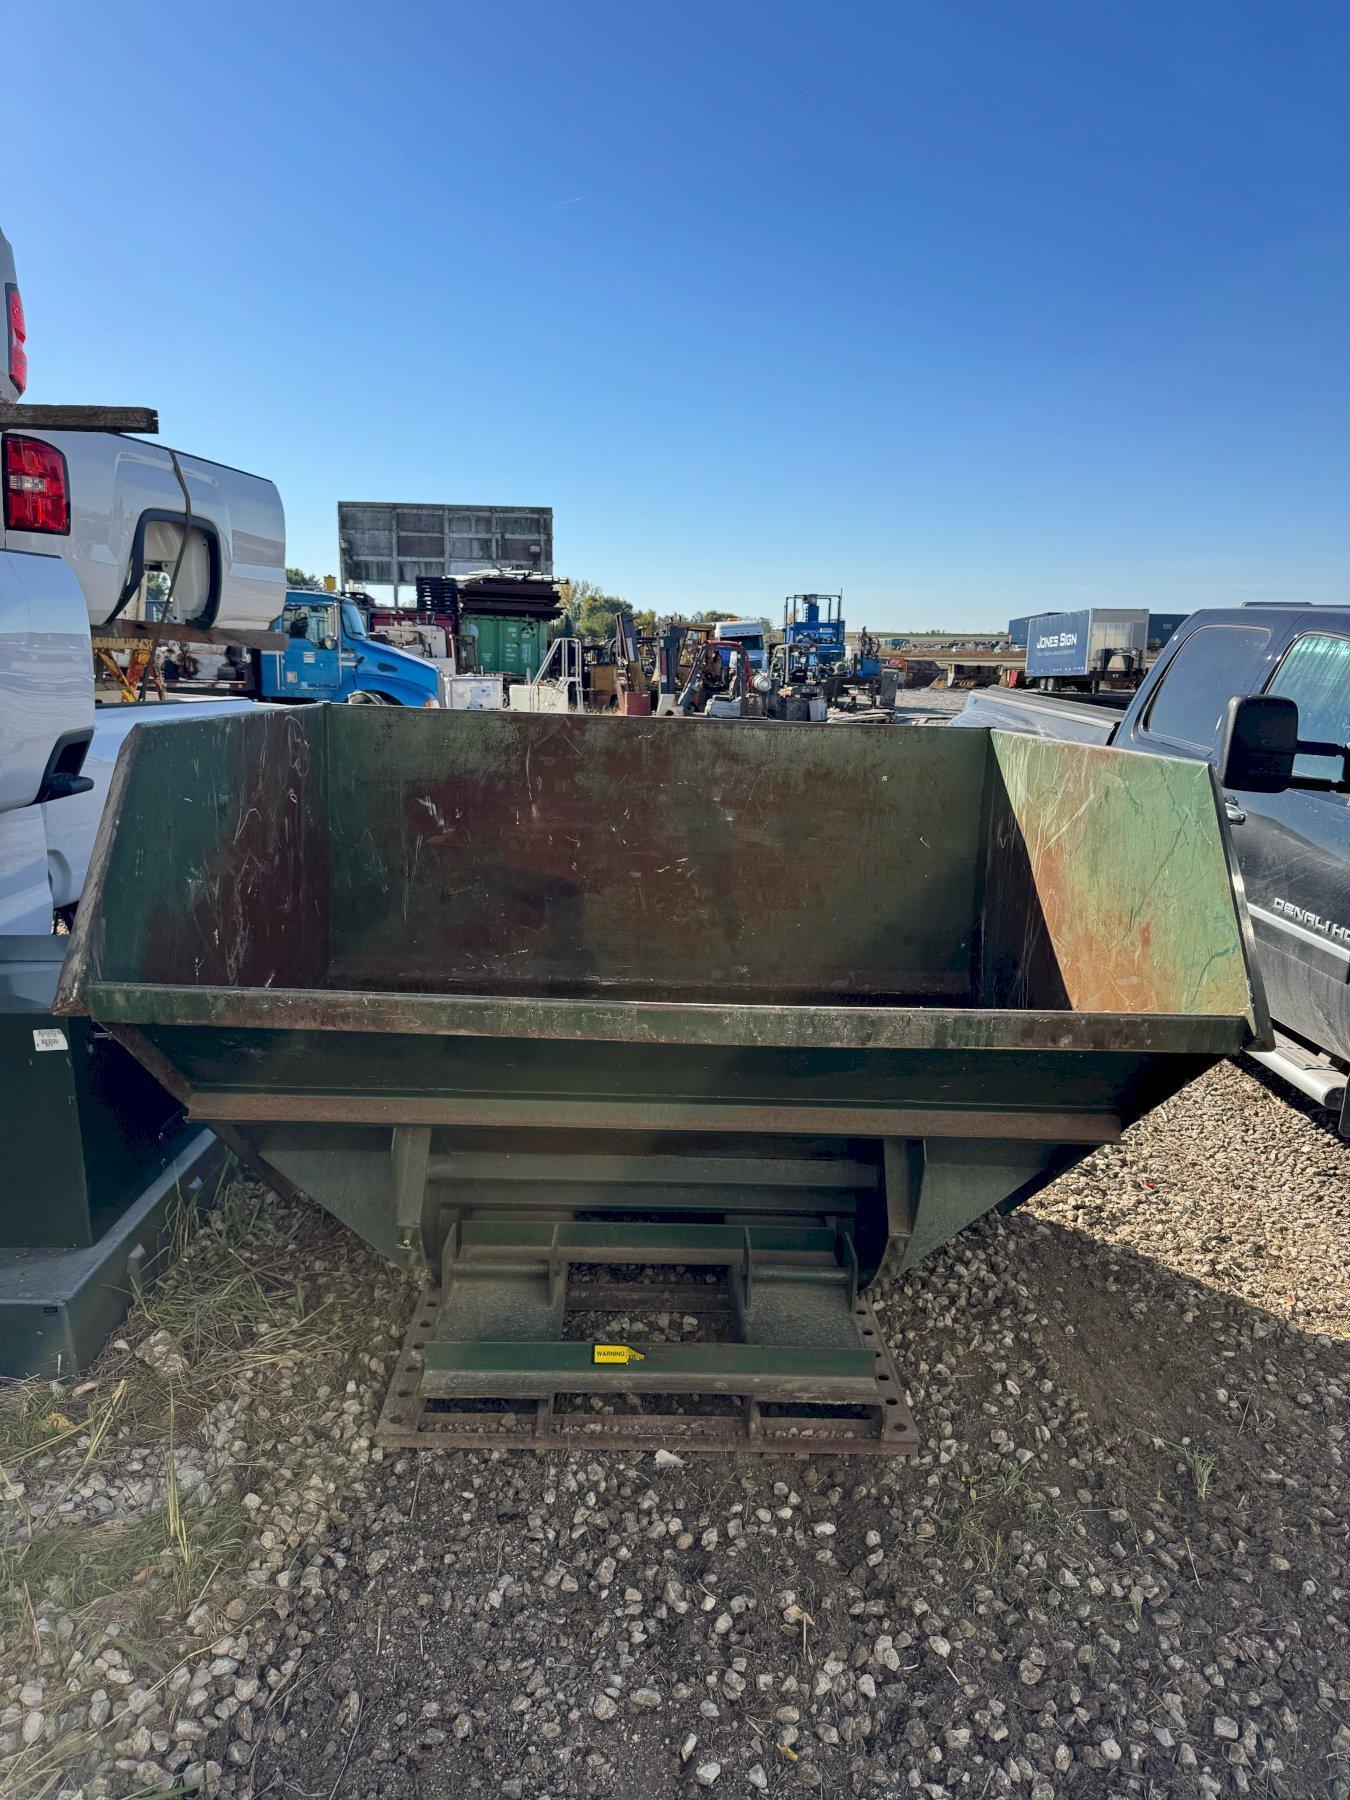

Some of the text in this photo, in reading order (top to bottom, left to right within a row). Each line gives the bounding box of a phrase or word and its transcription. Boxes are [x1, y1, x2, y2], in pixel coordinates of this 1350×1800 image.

[1037, 632, 1077, 649] JONES SIGN
[1273, 897, 1331, 933] DENALI
